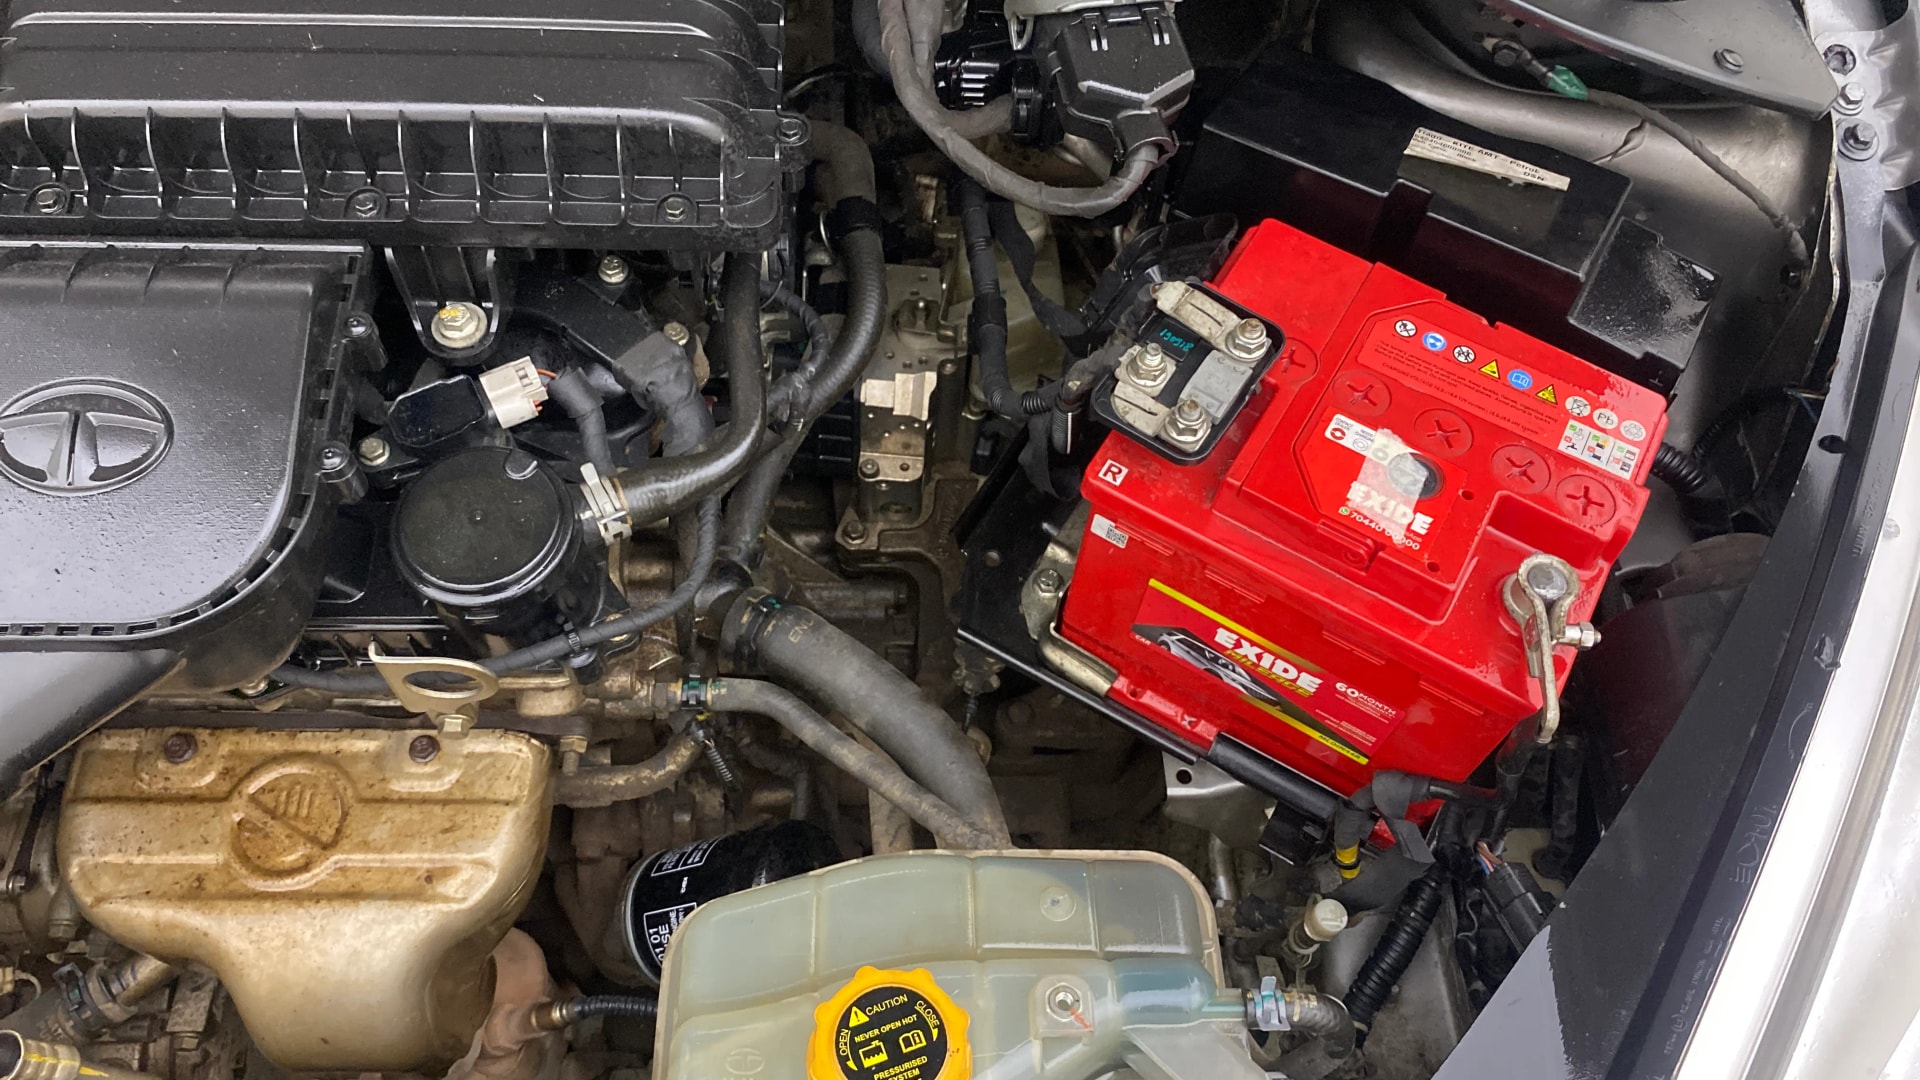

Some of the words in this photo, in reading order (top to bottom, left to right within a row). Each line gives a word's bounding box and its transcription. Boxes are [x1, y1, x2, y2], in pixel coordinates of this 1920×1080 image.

[1509, 159, 1540, 174] Petrol
[1597, 412, 1614, 426] Pb
[1102, 462, 1123, 485] R
[1347, 481, 1433, 535] EXIDE
[1350, 512, 1382, 532] 70440
[1134, 634, 1151, 646] CAR
[1214, 628, 1323, 693] EXIDE
[1335, 682, 1358, 699] 60
[1359, 693, 1396, 715] MONTH
[648, 928, 660, 943] 01
[866, 994, 908, 1016] CAUTION
[916, 1000, 940, 1027] CLOSE
[854, 1029, 880, 1043] NEVER
[881, 1020, 901, 1033] OPEN
[901, 1014, 917, 1025] HOT
[839, 1028, 849, 1056] OPEN
[873, 1056, 928, 1080] PRESSURISED
